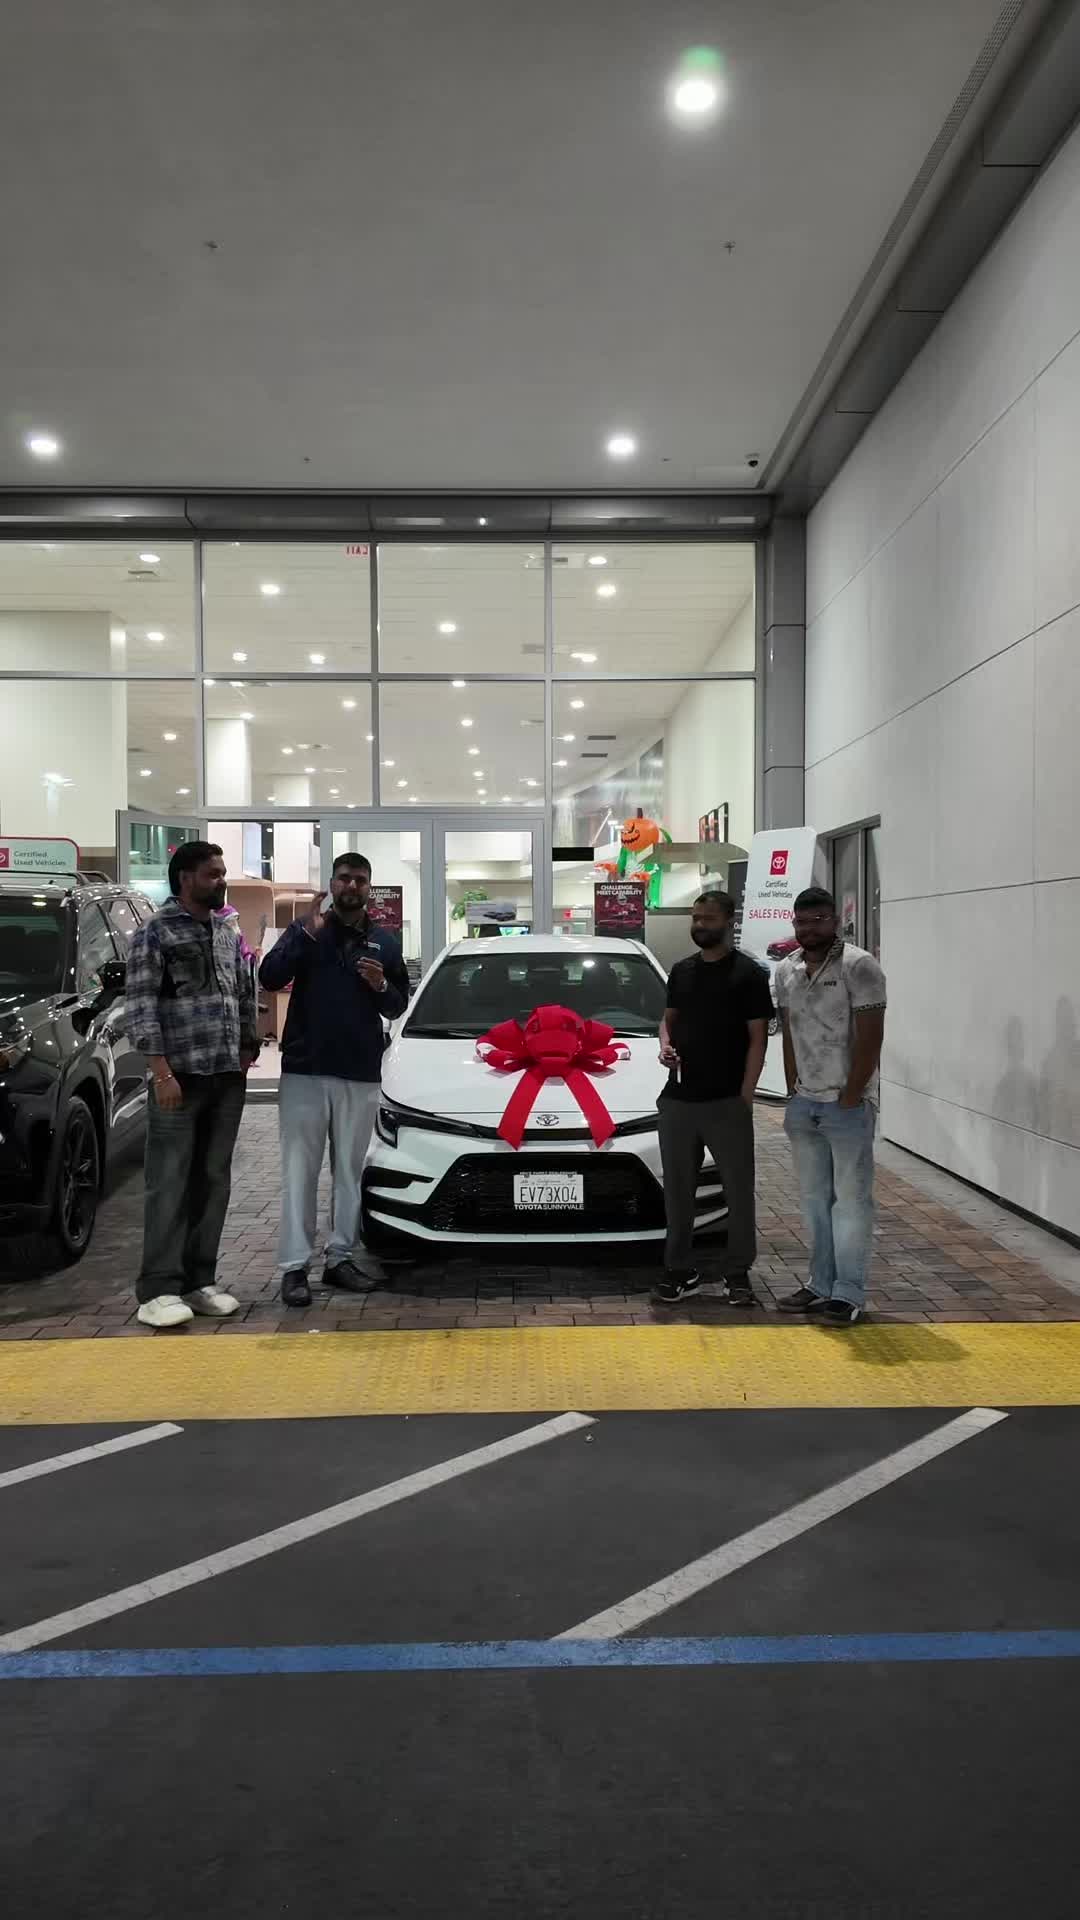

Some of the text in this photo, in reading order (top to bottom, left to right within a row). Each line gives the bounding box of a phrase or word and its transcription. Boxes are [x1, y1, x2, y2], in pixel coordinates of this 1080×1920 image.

[13, 850, 48, 858] Certified
[765, 880, 788, 888] Certified
[772, 889, 793, 898] Vehicles
[748, 908, 794, 919] SALES EVEN
[520, 1186, 577, 1203] EV73X04
